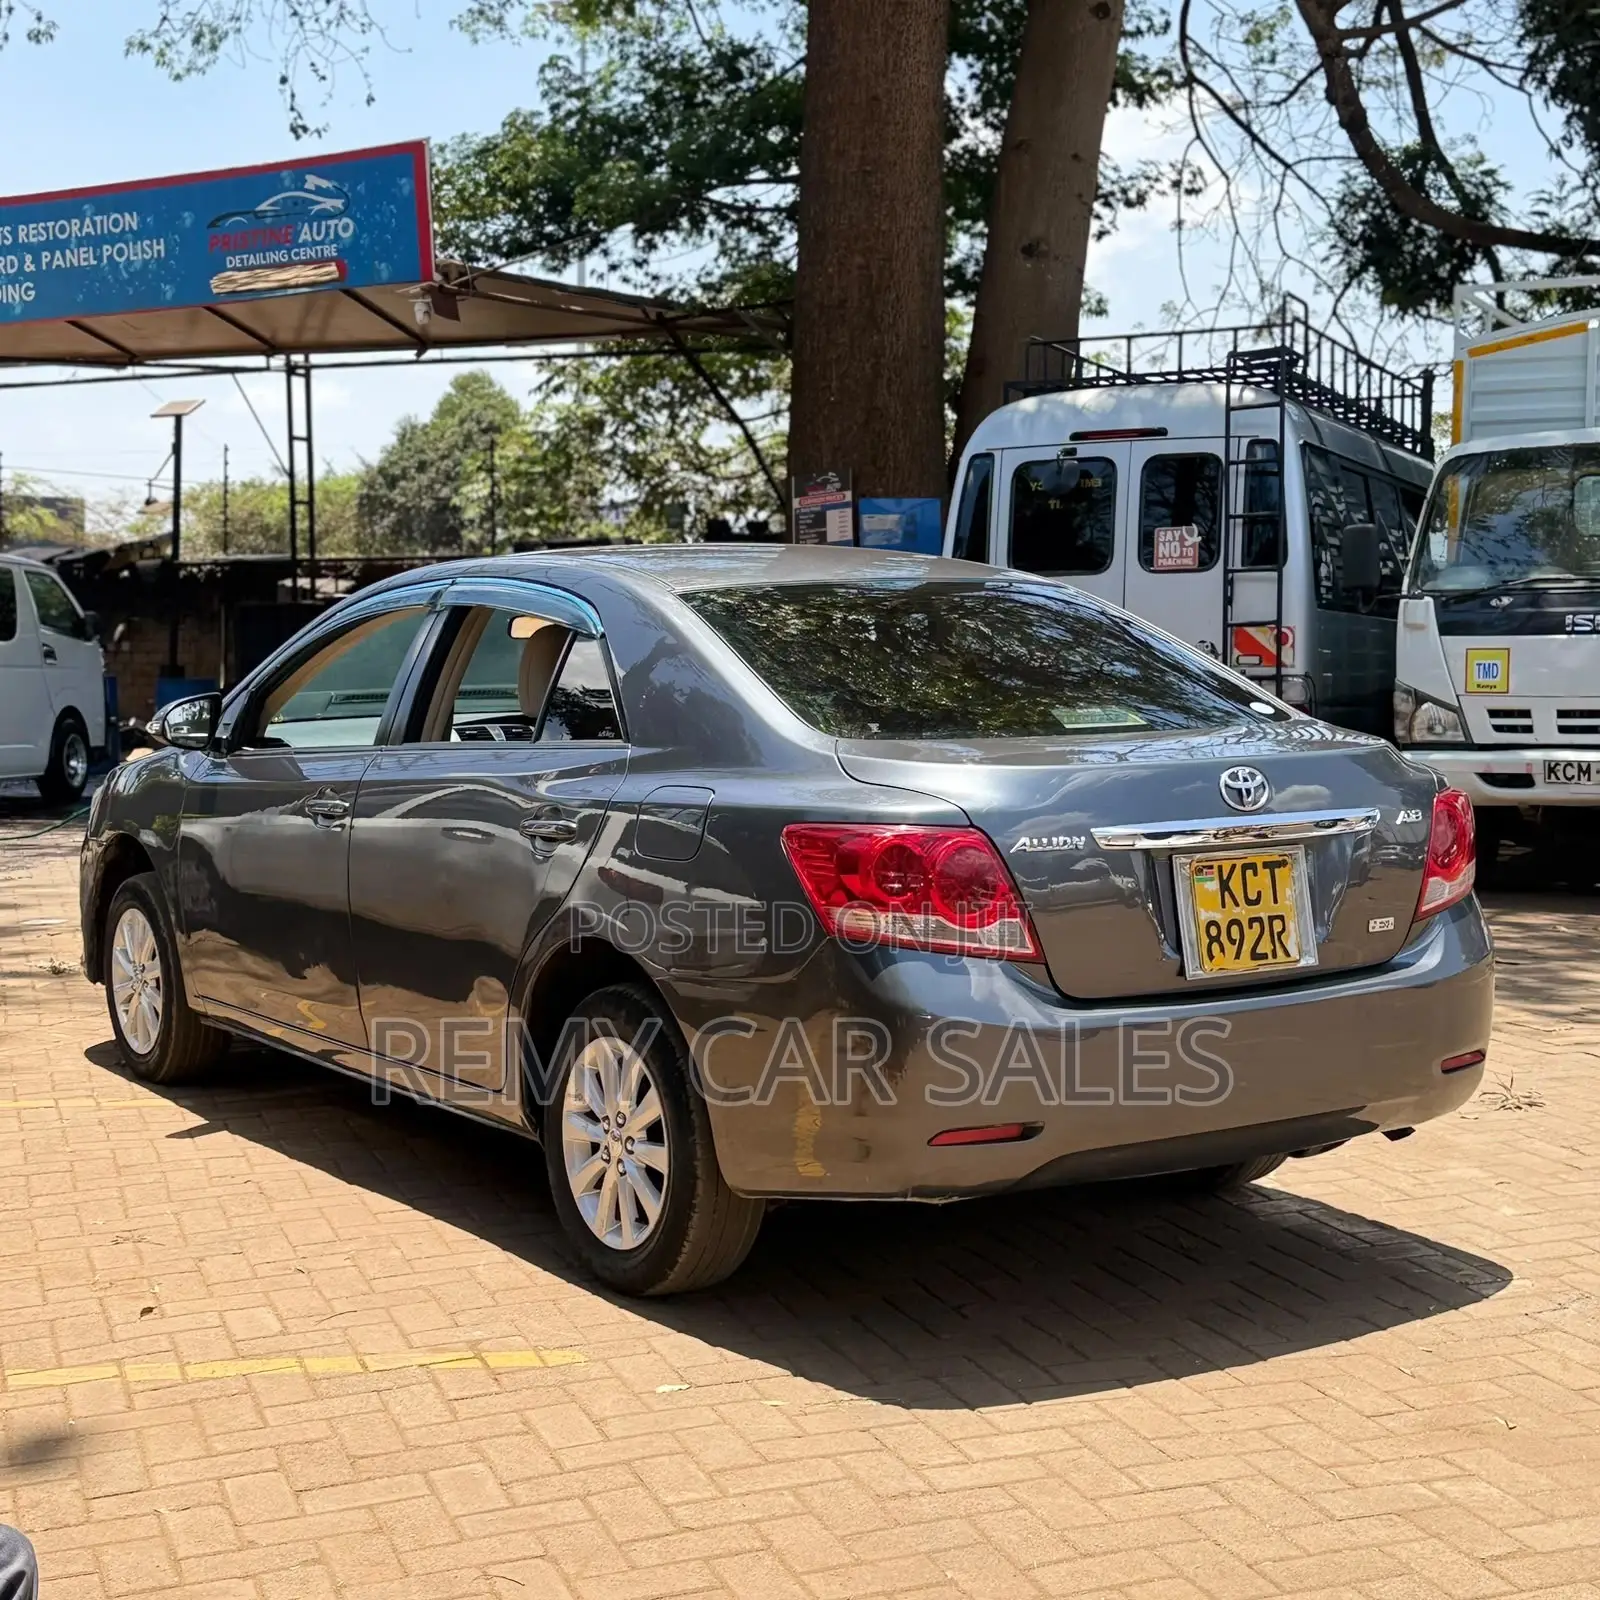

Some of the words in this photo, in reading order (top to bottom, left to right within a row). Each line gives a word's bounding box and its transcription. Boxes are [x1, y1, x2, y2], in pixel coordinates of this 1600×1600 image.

[18, 212, 138, 243] RESTORATION
[209, 224, 295, 253] PRISTINE
[298, 217, 354, 243] AUTO
[24, 252, 36, 272] &
[41, 246, 98, 270] PANEL
[102, 238, 165, 263] POLISH
[226, 250, 289, 268] DETAILING
[291, 244, 338, 261] CENTRE
[0, 281, 36, 304] ING
[1159, 530, 1180, 542] SAY
[1158, 541, 1180, 558] NO
[1182, 547, 1194, 557] TO
[1475, 662, 1499, 679] TMD
[1009, 836, 1086, 853] ALLION
[1217, 859, 1288, 909] KCT
[1205, 914, 1292, 962] 892R
